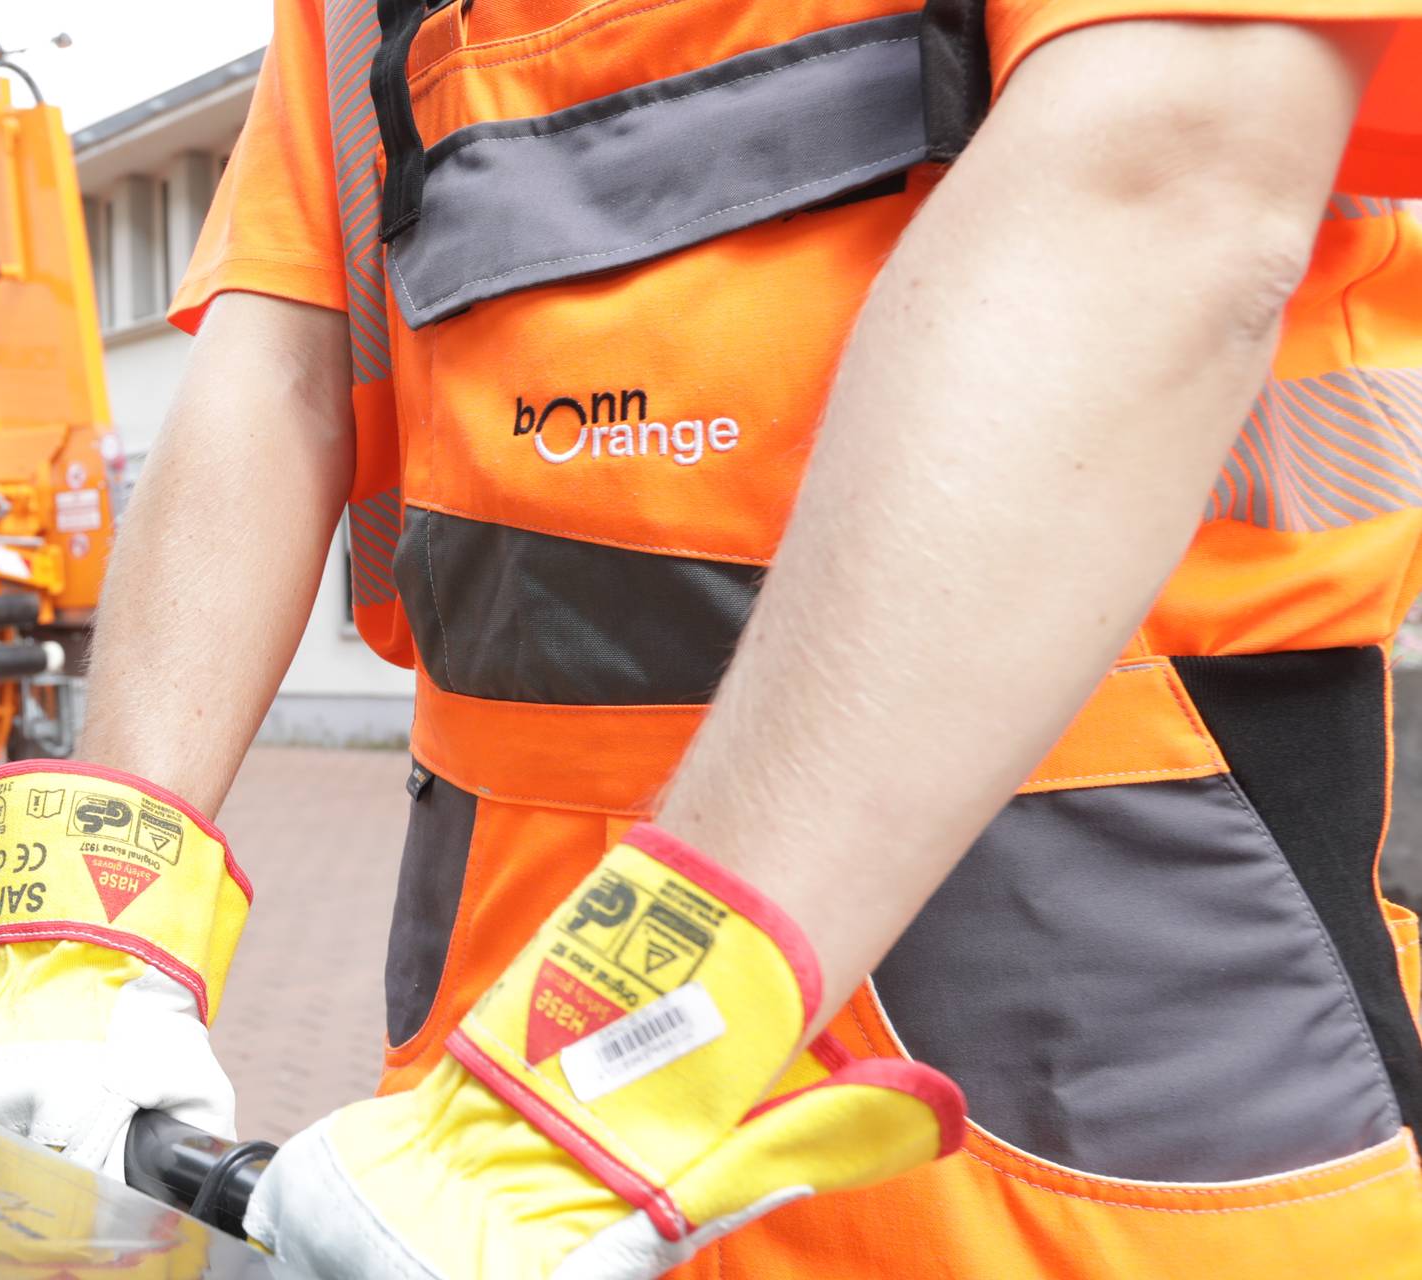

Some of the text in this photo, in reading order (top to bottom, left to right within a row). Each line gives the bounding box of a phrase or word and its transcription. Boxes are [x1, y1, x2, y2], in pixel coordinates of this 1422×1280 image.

[76, 799, 134, 834] GS
[79, 841, 100, 852] 1937
[128, 850, 161, 870] Original
[99, 871, 140, 893] Hase
[123, 864, 152, 882] Safety
[535, 988, 589, 1036] Hase
